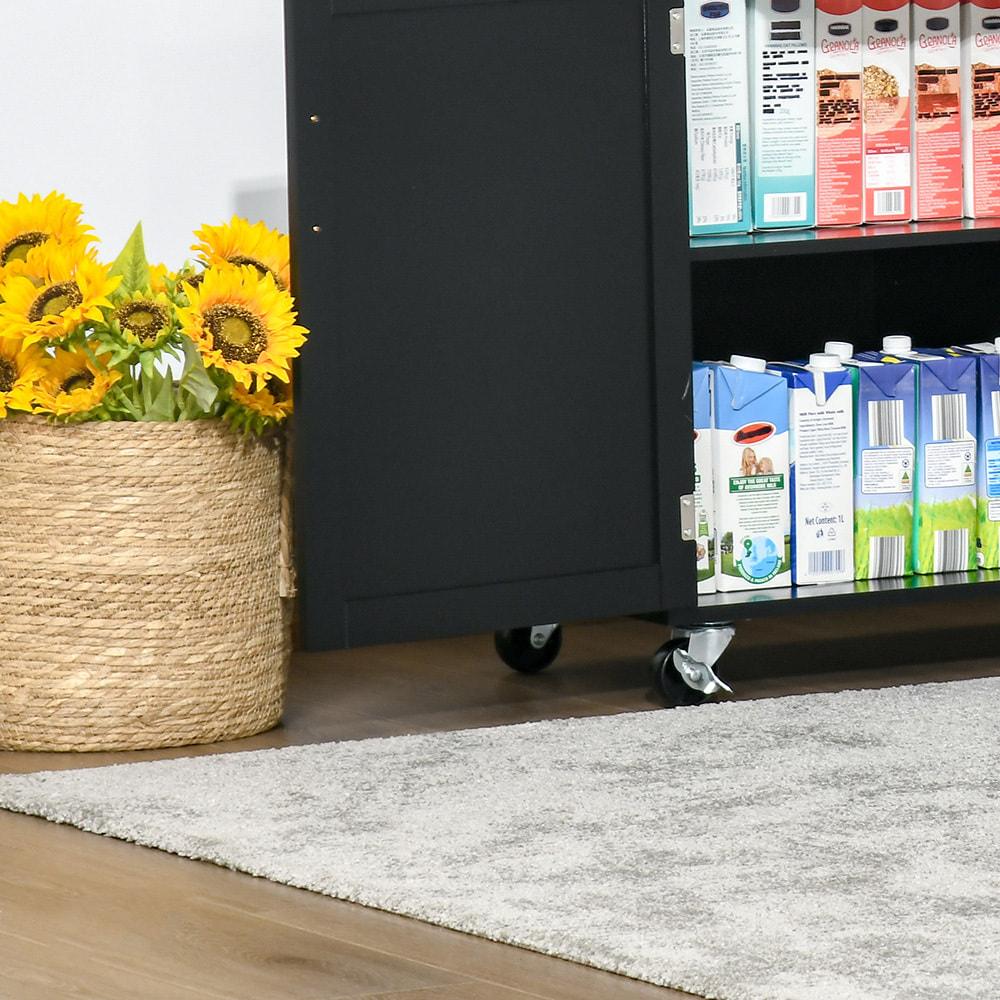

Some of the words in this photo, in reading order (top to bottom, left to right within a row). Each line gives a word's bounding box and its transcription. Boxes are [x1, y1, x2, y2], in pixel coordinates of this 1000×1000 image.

[821, 37, 859, 54] GRANOLA
[867, 33, 906, 50] GRANOLA
[919, 32, 957, 49] GRANOLA
[805, 517, 814, 525] Net
[815, 516, 837, 525] Content:
[838, 514, 844, 523] 1L
